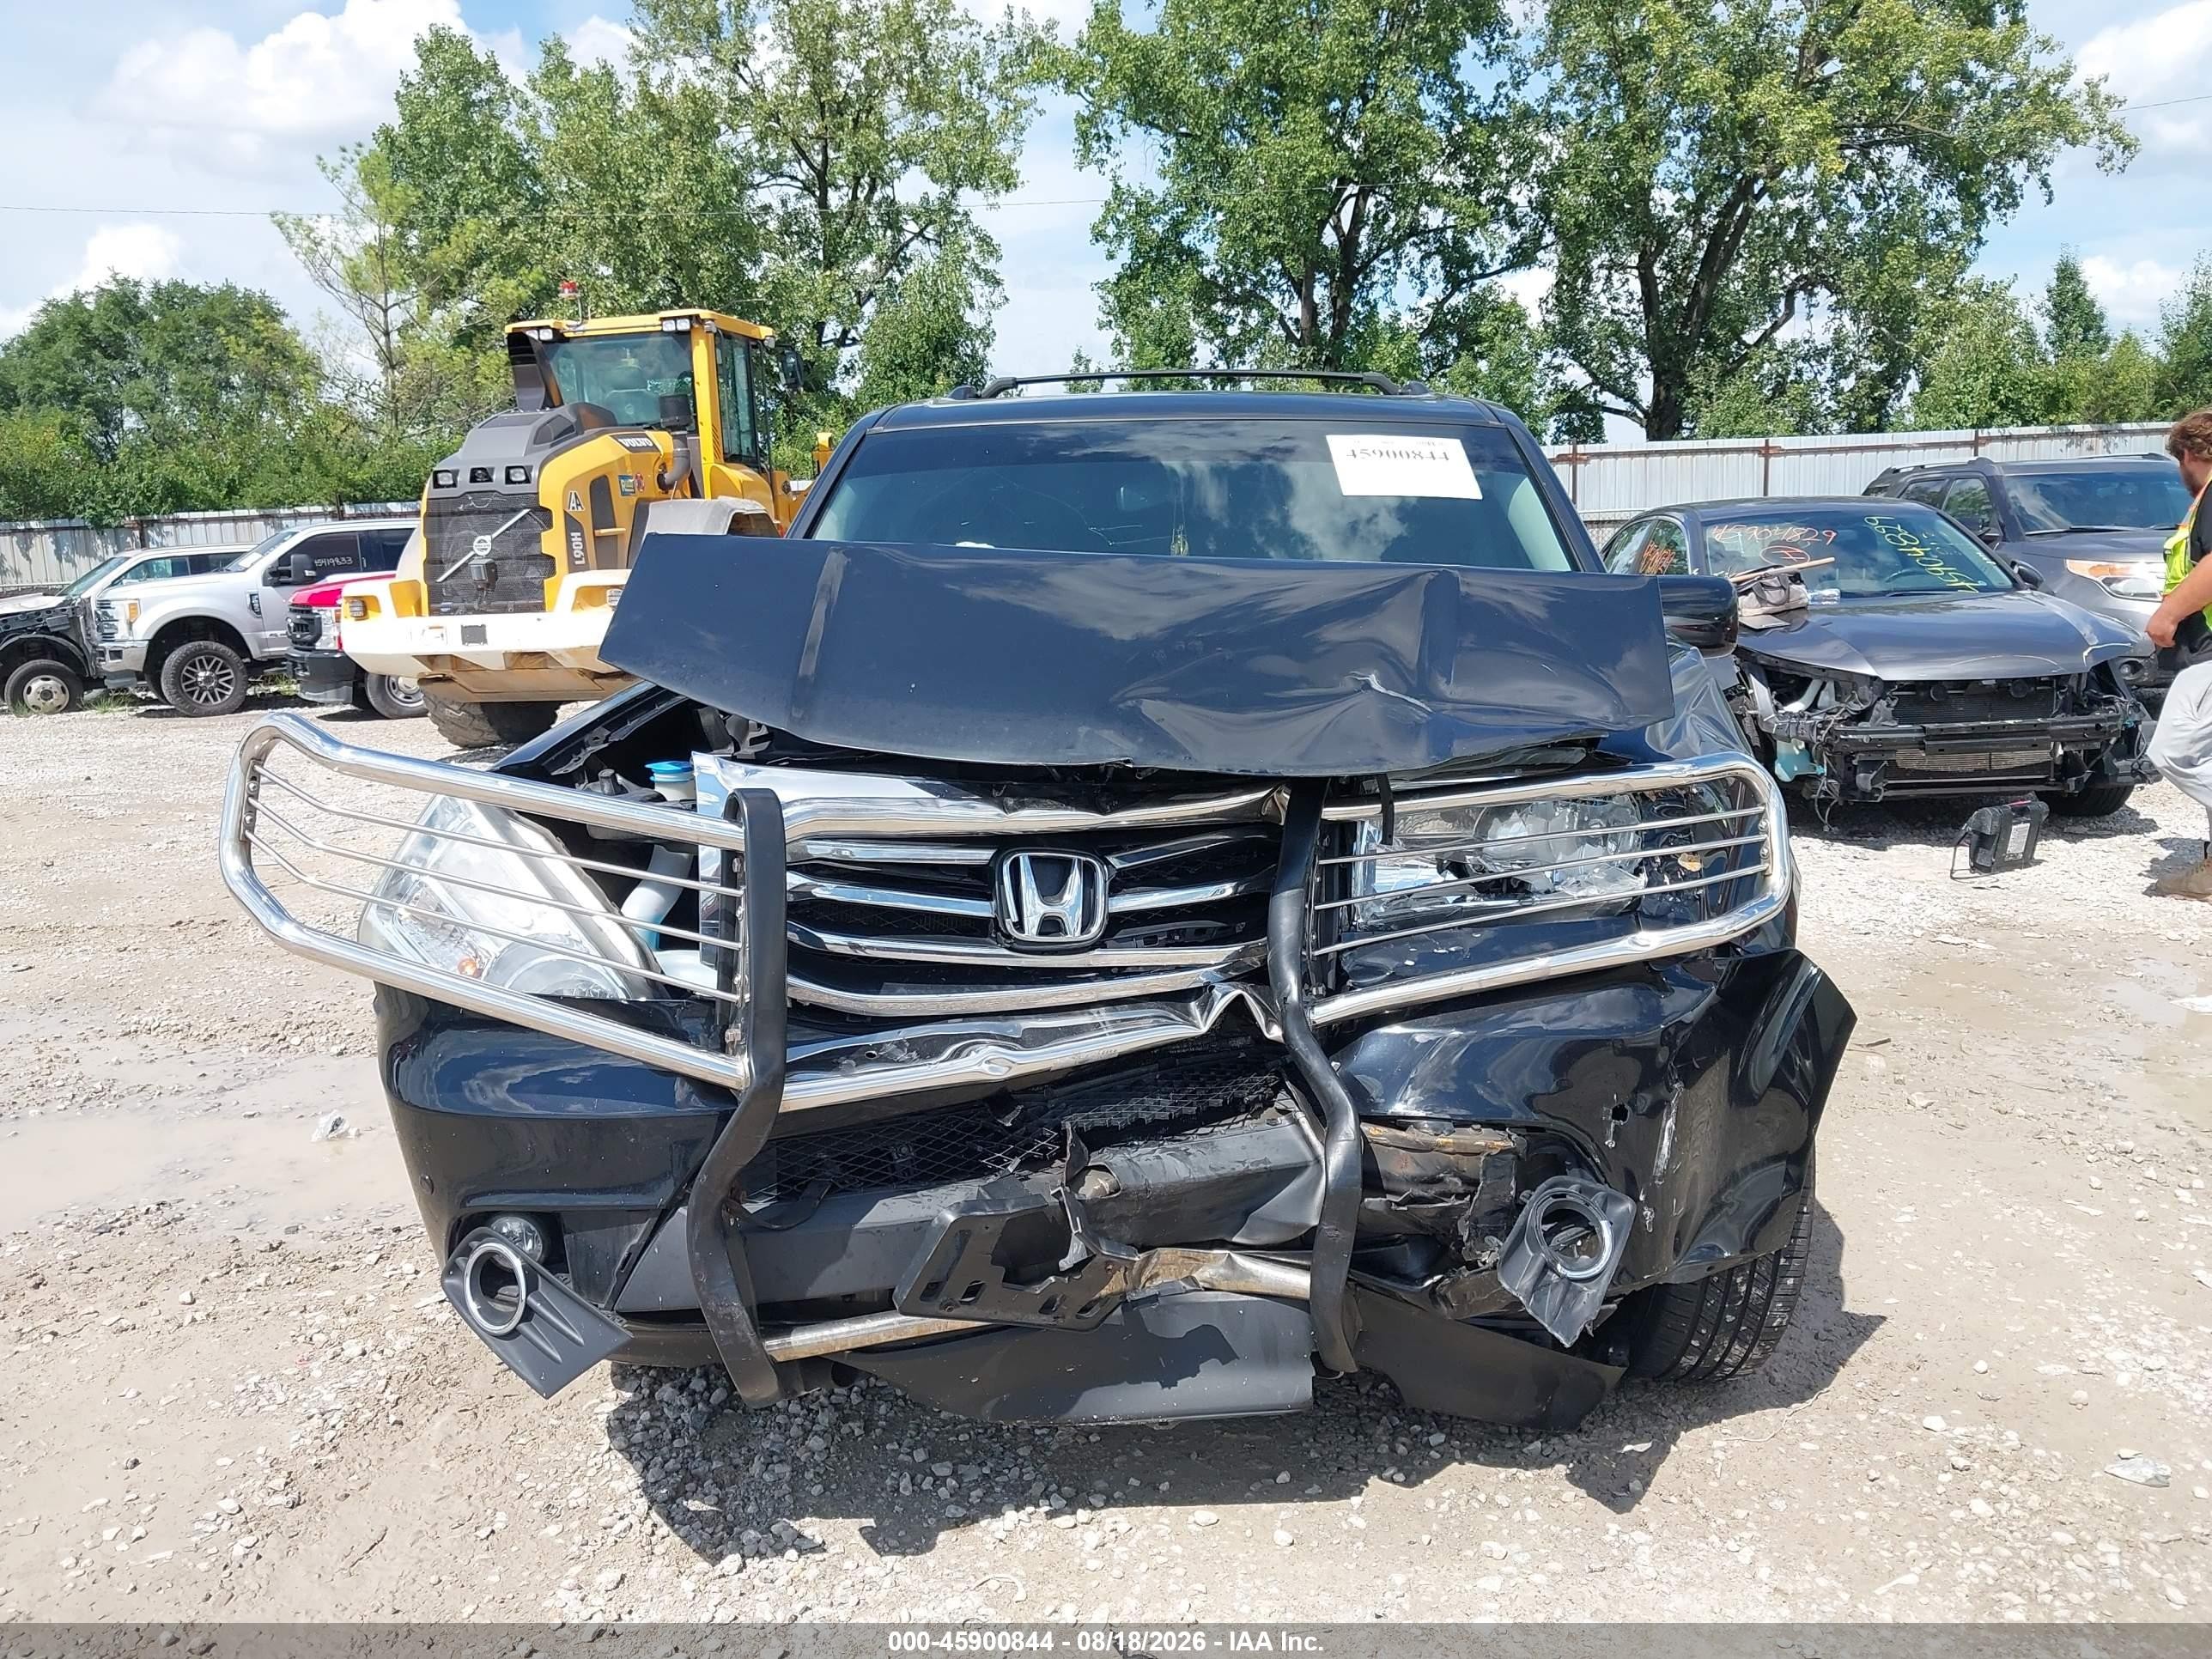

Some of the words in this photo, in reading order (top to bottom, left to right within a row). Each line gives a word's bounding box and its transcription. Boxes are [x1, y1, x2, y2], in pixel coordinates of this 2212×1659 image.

[617, 437, 654, 447] VOLVO
[1346, 448, 1450, 461] 45900844
[570, 531, 586, 566] L90H
